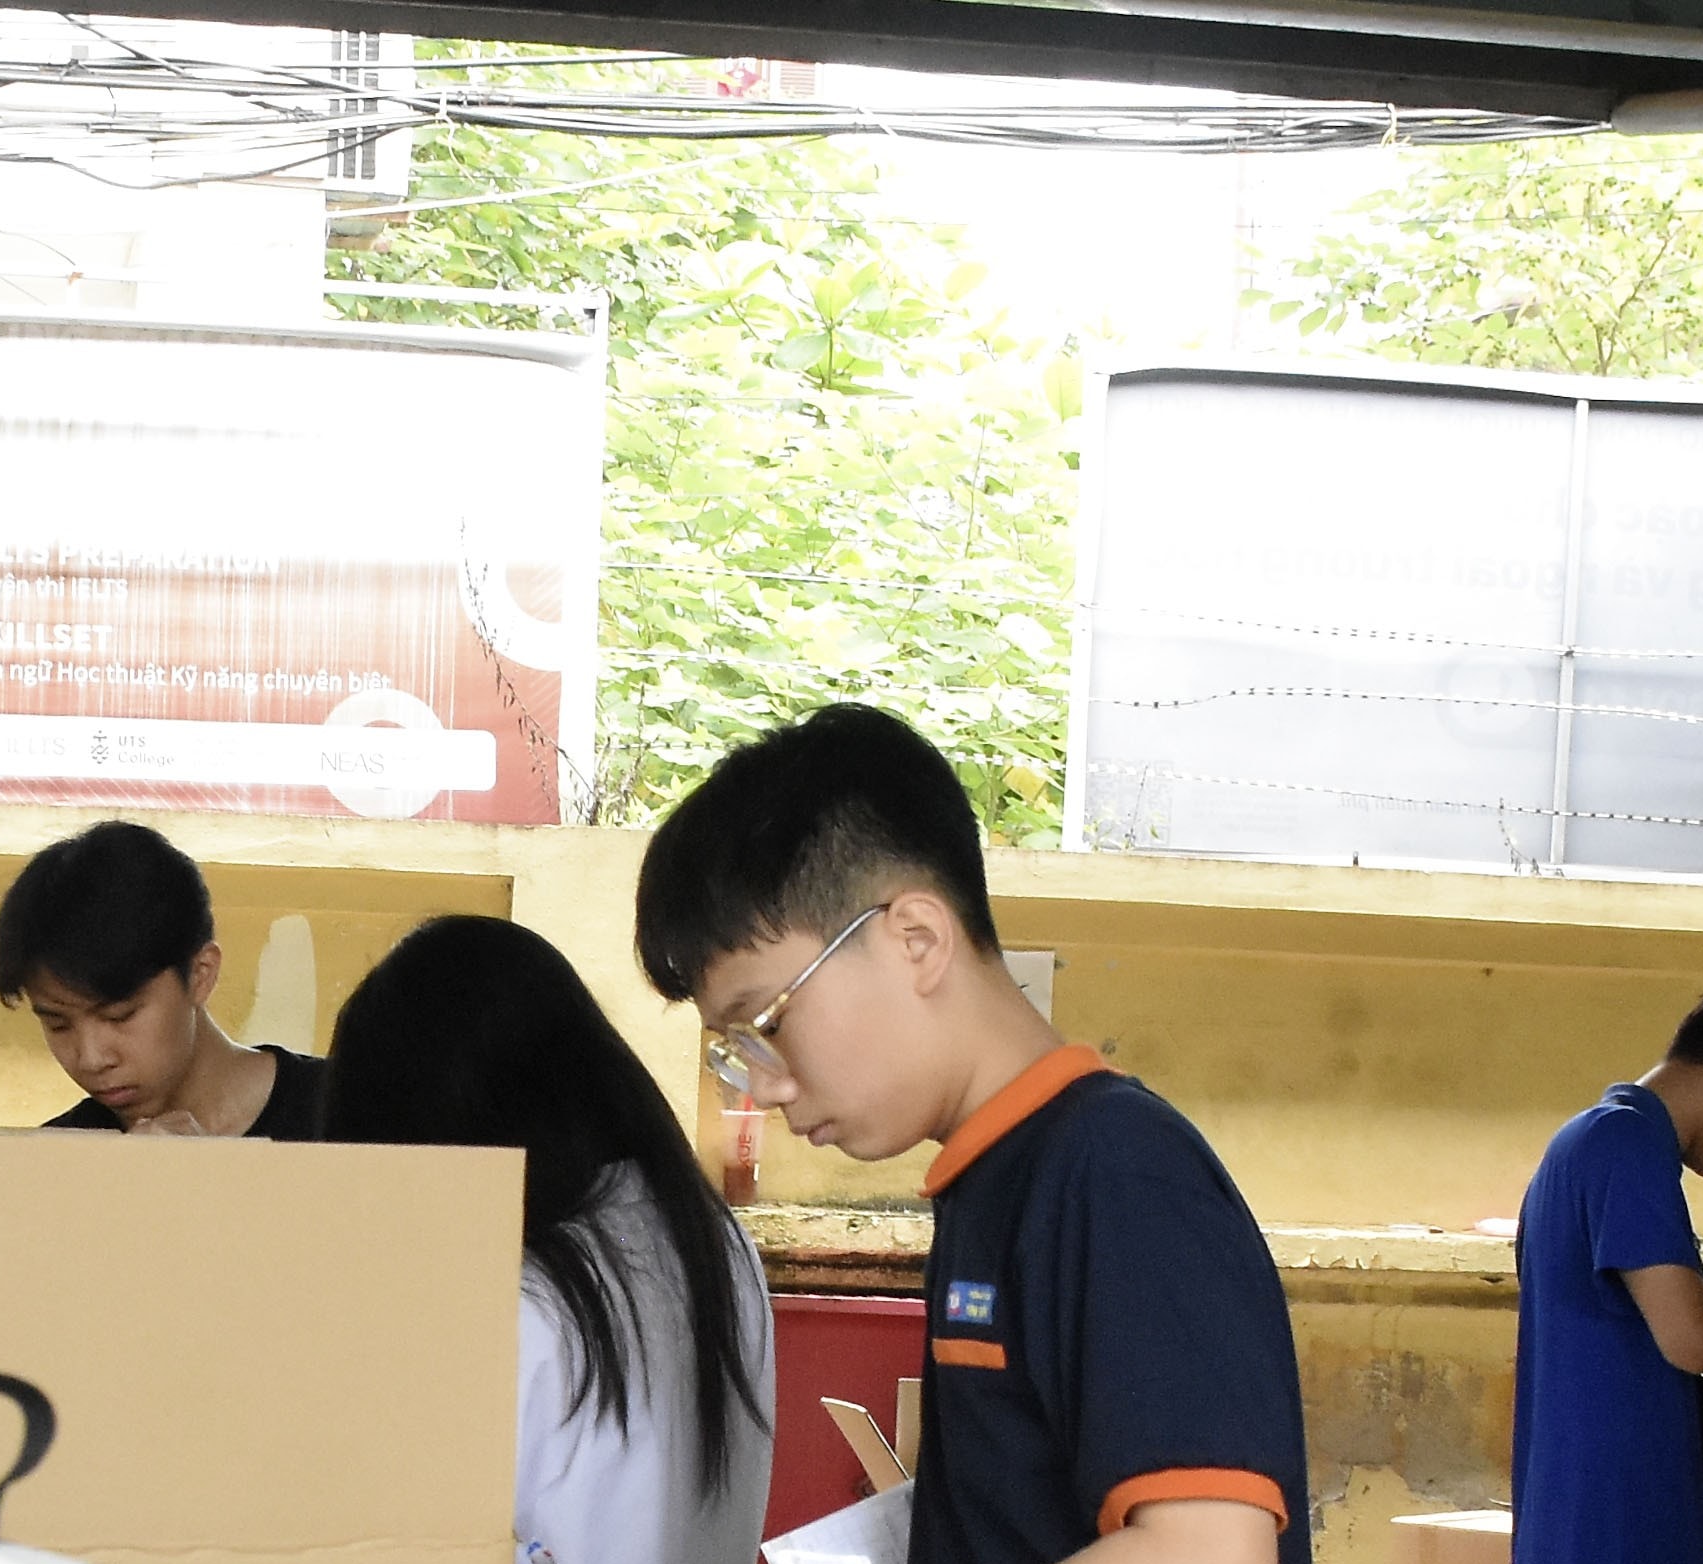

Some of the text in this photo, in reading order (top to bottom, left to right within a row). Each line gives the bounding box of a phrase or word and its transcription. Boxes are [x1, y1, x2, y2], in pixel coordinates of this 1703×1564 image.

[35, 575, 65, 597] thi
[72, 578, 128, 600] IELTS
[9, 659, 50, 686] ngữ
[58, 662, 101, 688] Học
[107, 662, 165, 689] thuật
[171, 664, 197, 689] Kỹ
[203, 668, 257, 696] năng
[263, 669, 342, 695] chuyên
[118, 751, 175, 768] College
[321, 752, 385, 773] NEAS
